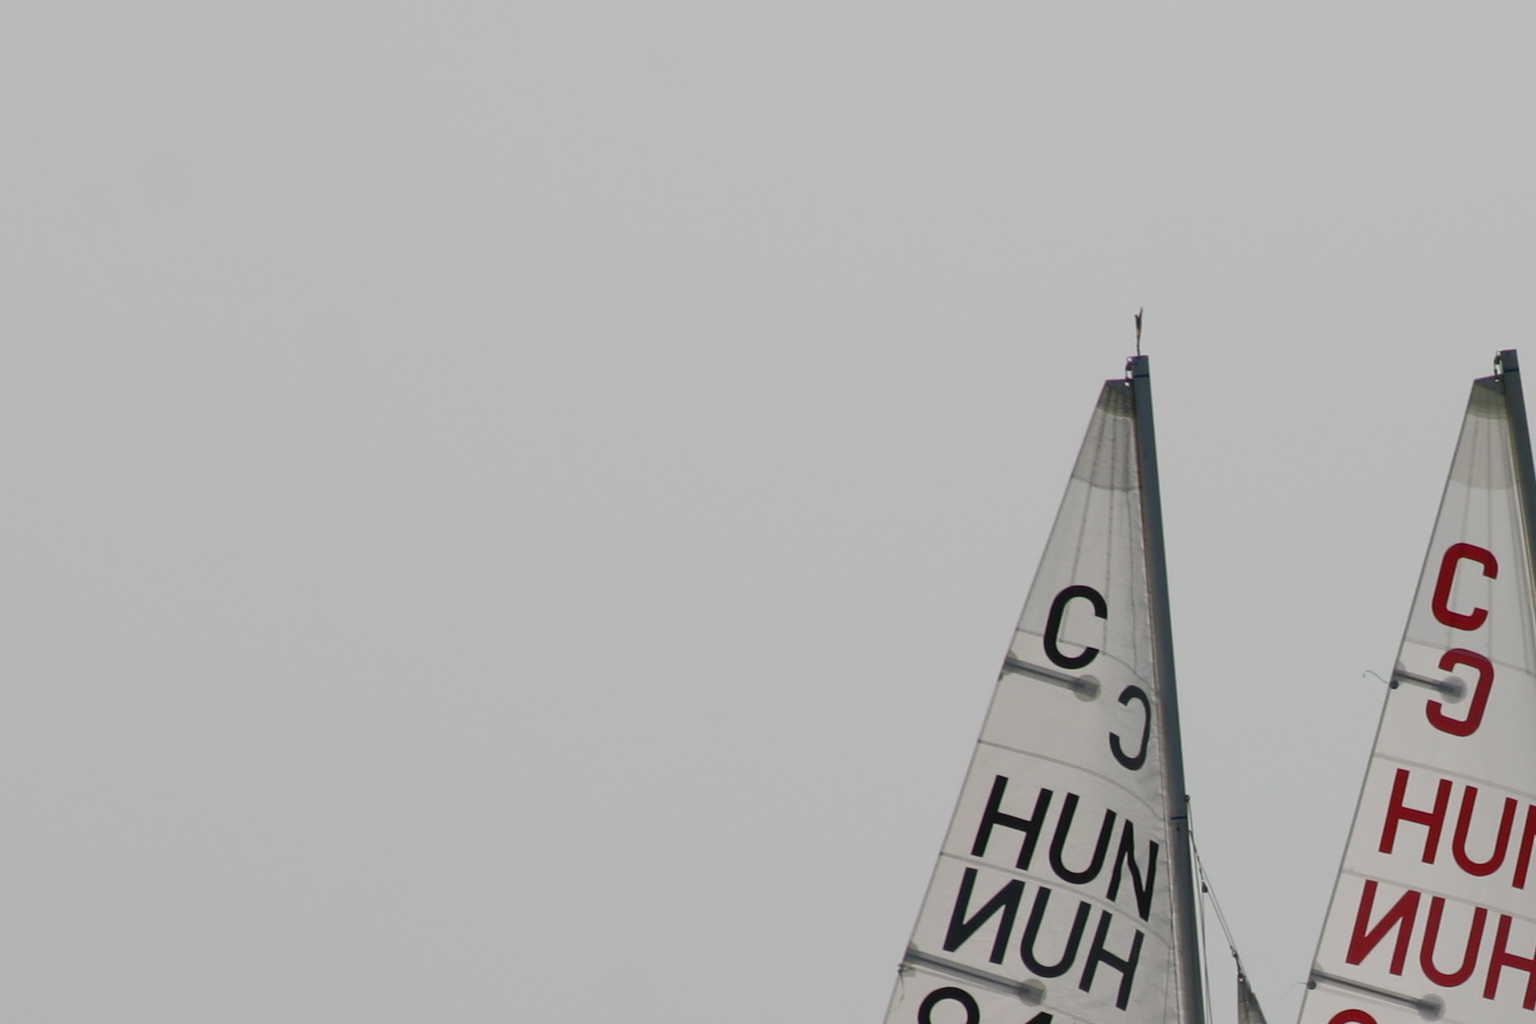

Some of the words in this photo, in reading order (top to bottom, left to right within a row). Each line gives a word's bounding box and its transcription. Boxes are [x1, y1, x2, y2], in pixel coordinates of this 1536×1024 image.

[1043, 585, 1108, 670] C
[1431, 542, 1498, 631] C
[970, 774, 1159, 922] HUN
